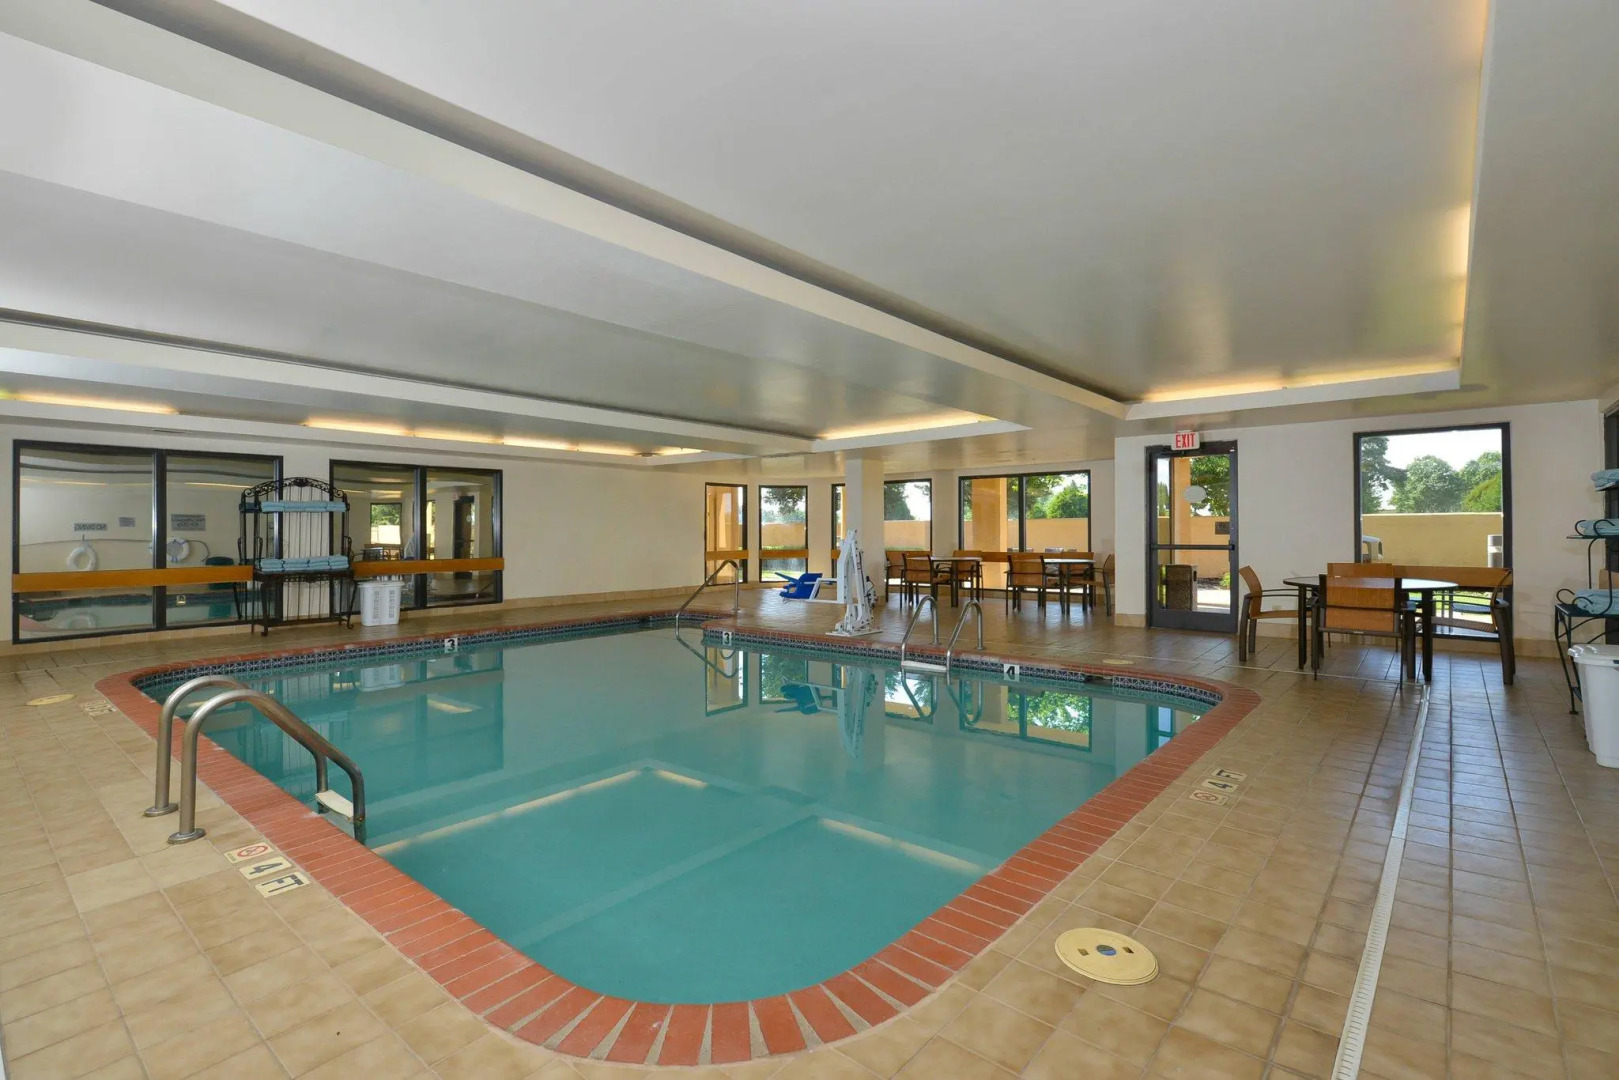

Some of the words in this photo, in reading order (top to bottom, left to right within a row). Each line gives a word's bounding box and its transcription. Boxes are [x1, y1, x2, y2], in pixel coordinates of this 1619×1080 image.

[1176, 433, 1195, 448] EXIT
[249, 861, 283, 876] 4
[261, 873, 305, 894] FT
